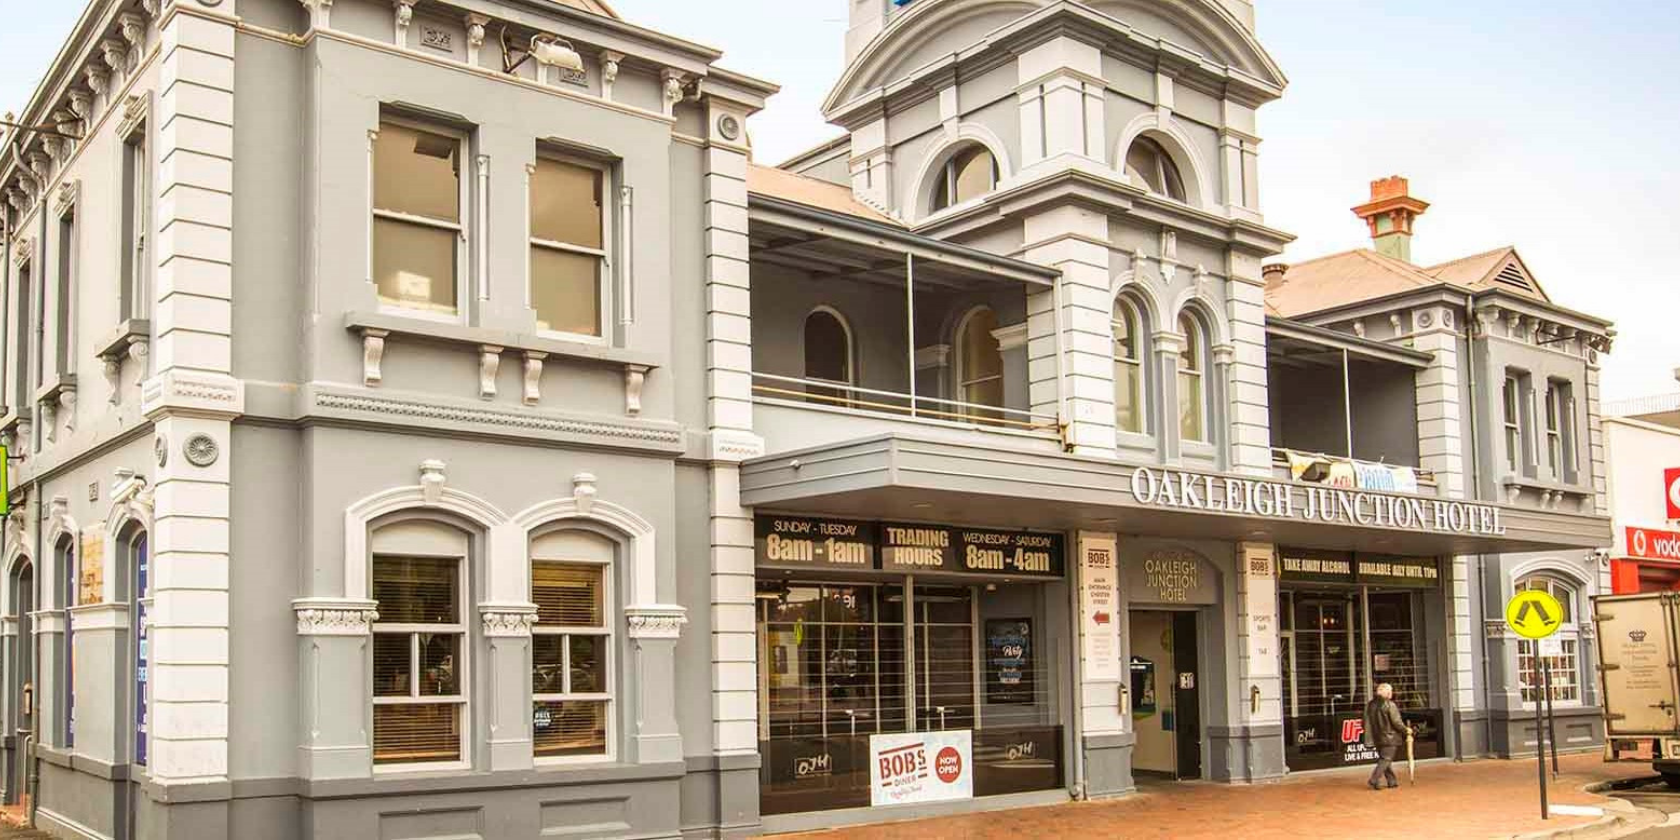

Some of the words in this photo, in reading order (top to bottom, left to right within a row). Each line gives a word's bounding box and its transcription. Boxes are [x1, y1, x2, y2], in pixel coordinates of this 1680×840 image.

[1131, 466, 1294, 517] OAKLEIGH
[1303, 487, 1427, 529] JUNCTION
[1433, 500, 1506, 536] HOTEL
[774, 520, 811, 533] SUNDAY
[819, 523, 858, 536] TUESDAY
[886, 528, 949, 547] TRADING
[963, 532, 1010, 545] WEDNESDAY
[1015, 537, 1051, 547] SATURDAY
[894, 547, 943, 566] HOURS
[1144, 559, 1197, 574] OAKLEIGH
[1283, 558, 1301, 571] TAKE
[1301, 559, 1321, 572] AWAY
[1321, 560, 1351, 574] ALCOHOL
[1358, 562, 1391, 576] AVAILABLE
[1405, 565, 1423, 578] UNTIL
[1145, 574, 1197, 588] JUNCTION
[1160, 588, 1187, 601] HOTEL
[1341, 718, 1365, 743] UF
[1008, 741, 1033, 760] OJH
[1344, 753, 1356, 761] LIVE
[1361, 751, 1373, 760] FREE
[797, 753, 829, 775] OJH
[939, 755, 958, 765] NOW
[938, 765, 958, 775] OPEN
[894, 776, 917, 787] DINER
